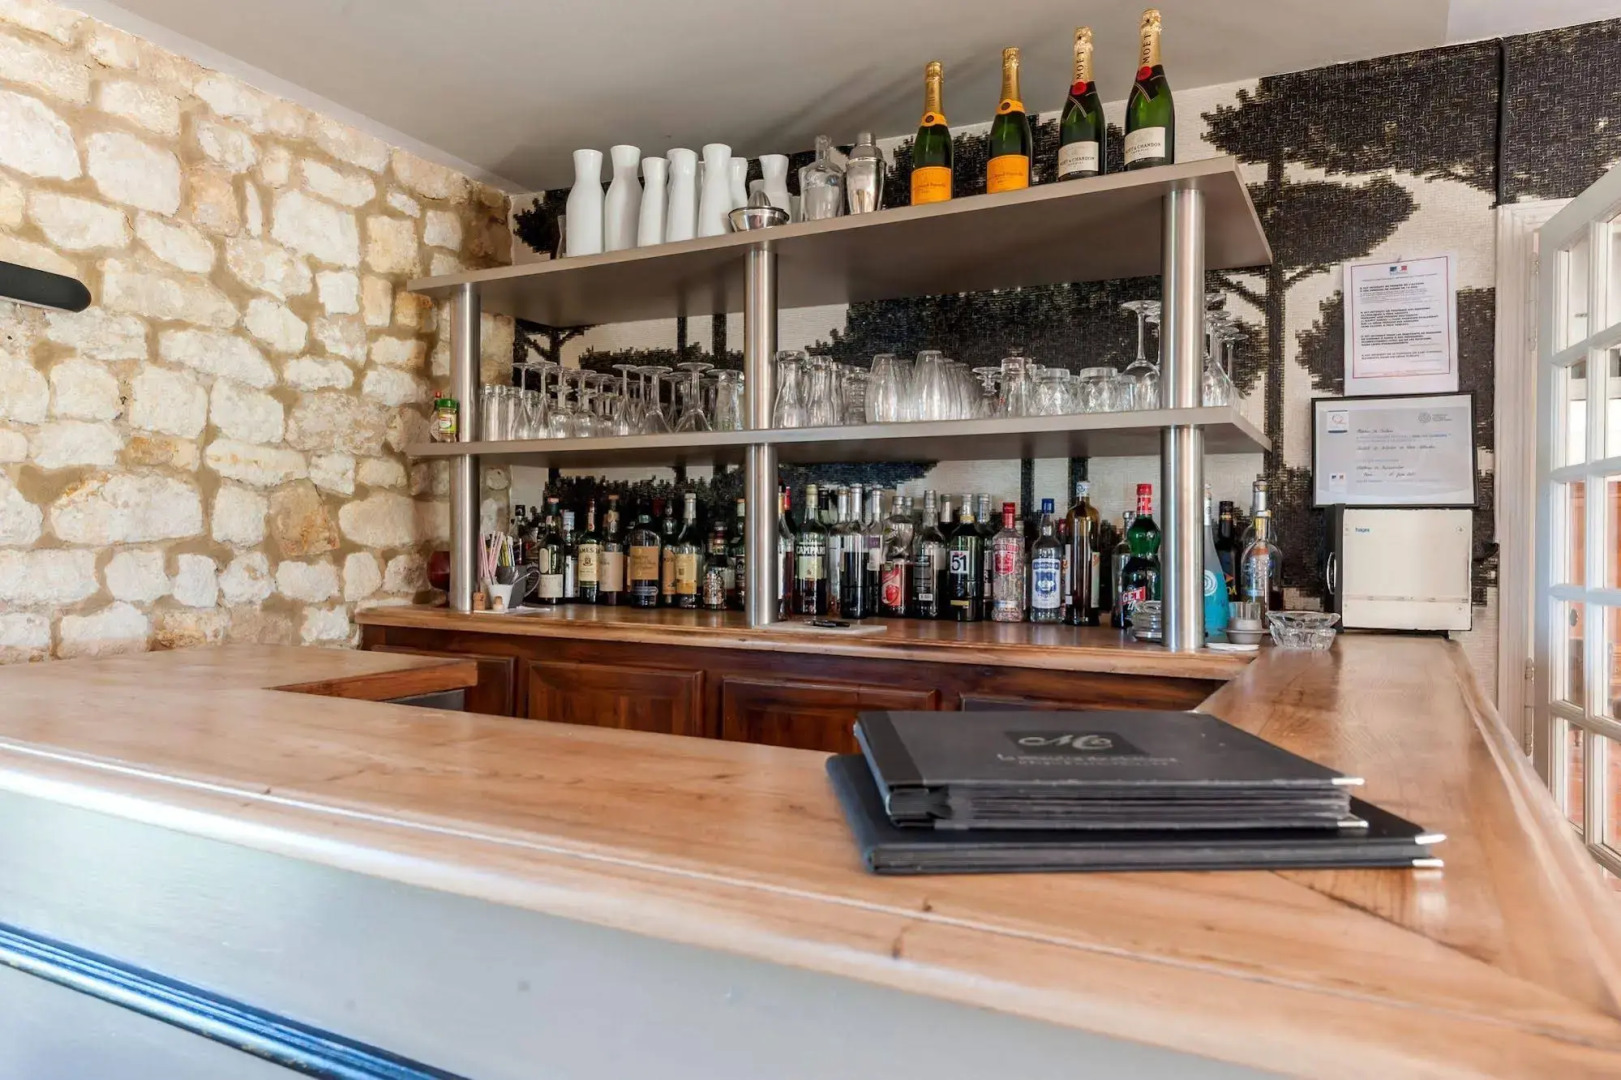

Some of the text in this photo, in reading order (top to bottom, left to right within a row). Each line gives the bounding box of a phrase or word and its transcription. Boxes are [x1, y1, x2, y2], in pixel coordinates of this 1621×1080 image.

[796, 545, 826, 555] CAMPARI
[951, 555, 967, 571] 51
[1122, 588, 1142, 603] GET
